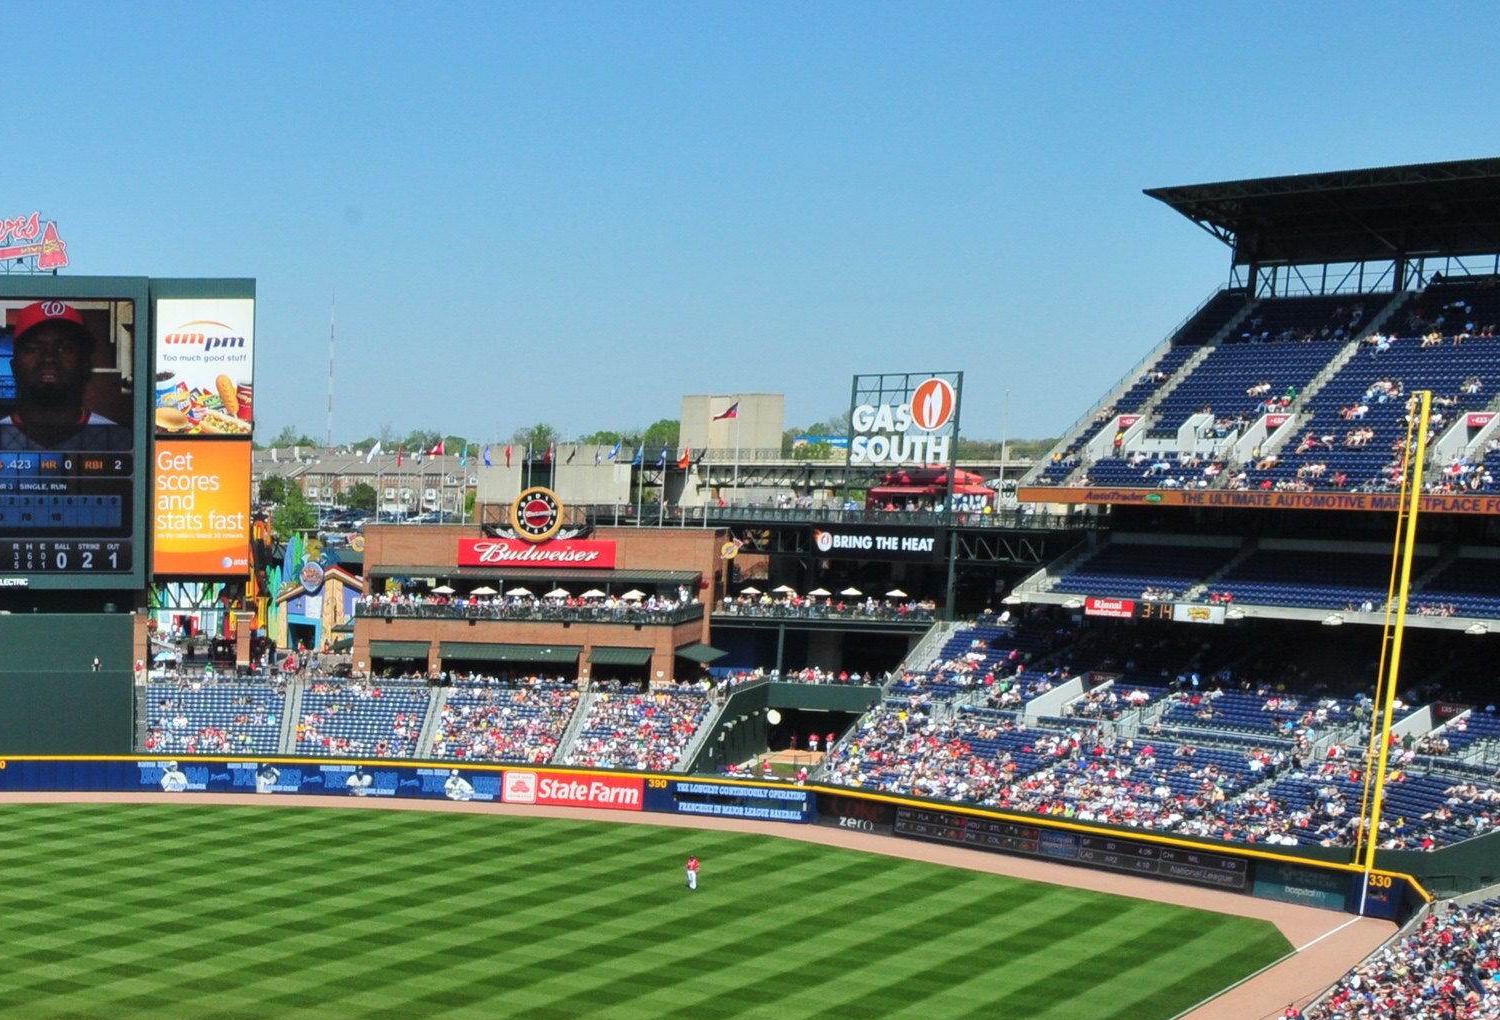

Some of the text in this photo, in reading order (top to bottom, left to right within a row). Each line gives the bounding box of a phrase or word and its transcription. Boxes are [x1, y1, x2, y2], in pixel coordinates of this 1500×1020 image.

[165, 333, 245, 351] ampm
[163, 354, 178, 362] Too
[203, 354, 225, 363] good
[227, 354, 247, 362] stuff
[852, 403, 913, 432] GAS
[850, 435, 950, 464] SOUTH
[7, 460, 32, 469] .423
[41, 461, 57, 469] HR
[64, 460, 72, 469] 0
[84, 461, 104, 469] RBI
[114, 460, 122, 469] 2
[157, 450, 194, 471] Get
[157, 474, 220, 491] scores
[157, 491, 195, 511] and
[1181, 492, 1205, 504] THE
[1209, 493, 1271, 506] ULTIMATE
[1275, 494, 1365, 508] AUTOMOTIVE
[157, 510, 245, 531] stats fast
[833, 534, 935, 551] BRING THE HEAT
[56, 552, 67, 569] 0
[82, 552, 93, 569] 2
[108, 552, 117, 568] 1
[473, 542, 600, 563] Budweiser
[1094, 600, 1122, 609] Rinnai
[1141, 602, 1173, 620] 3:14
[648, 779, 667, 788] 390
[676, 783, 807, 801] THE LONGEST CONTINUOUSLY OPERATING
[678, 802, 801, 820] FRANCHISE IN MAJOR LEAGUE BASEBALL
[839, 816, 874, 831] zero
[1170, 864, 1200, 877] National
[1201, 869, 1234, 883] League
[1369, 874, 1392, 889] 330
